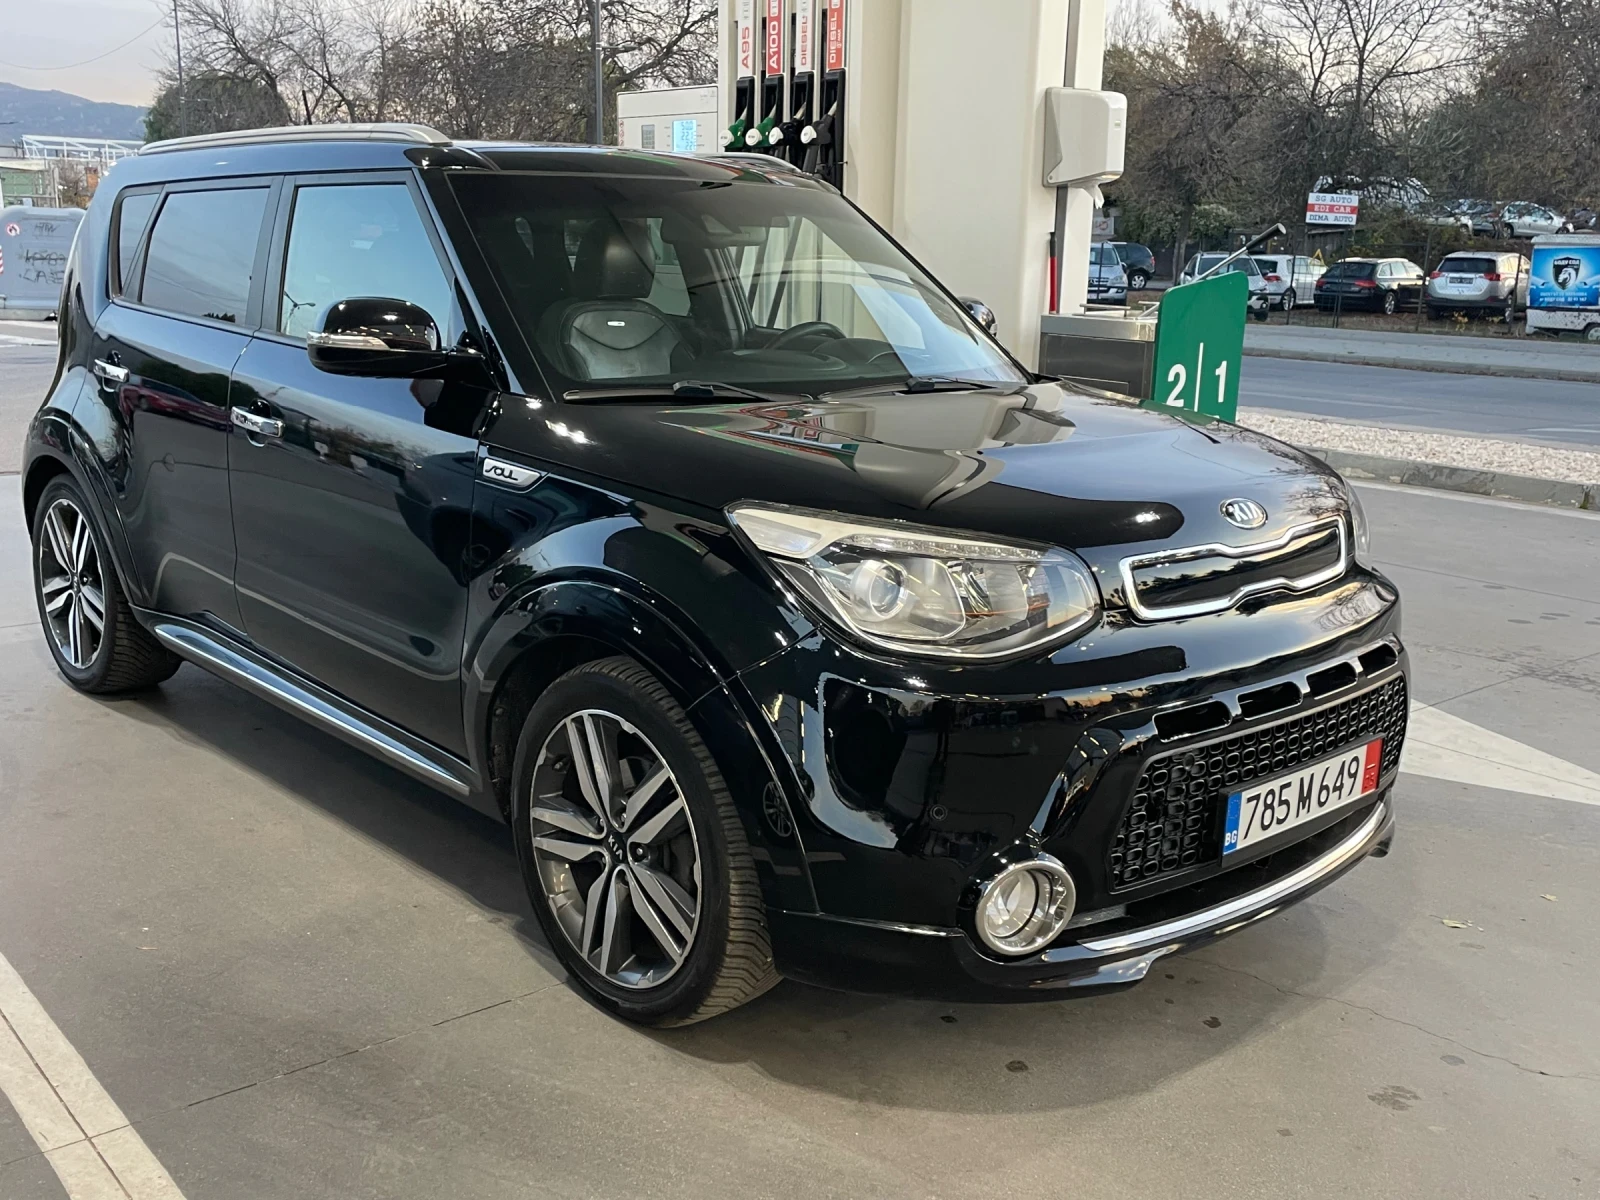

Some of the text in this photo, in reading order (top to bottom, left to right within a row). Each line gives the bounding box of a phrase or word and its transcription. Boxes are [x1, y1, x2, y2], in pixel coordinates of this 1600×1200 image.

[741, 26, 750, 69] A95
[769, 21, 779, 69] A100
[829, 12, 837, 64] DIESEL
[1333, 205, 1351, 213] CAR
[1165, 360, 1228, 408] 2 1
[1243, 781, 1292, 840] 785
[1317, 755, 1360, 808] 649
[608, 834, 623, 860] KIA
[1225, 830, 1238, 847] BG
